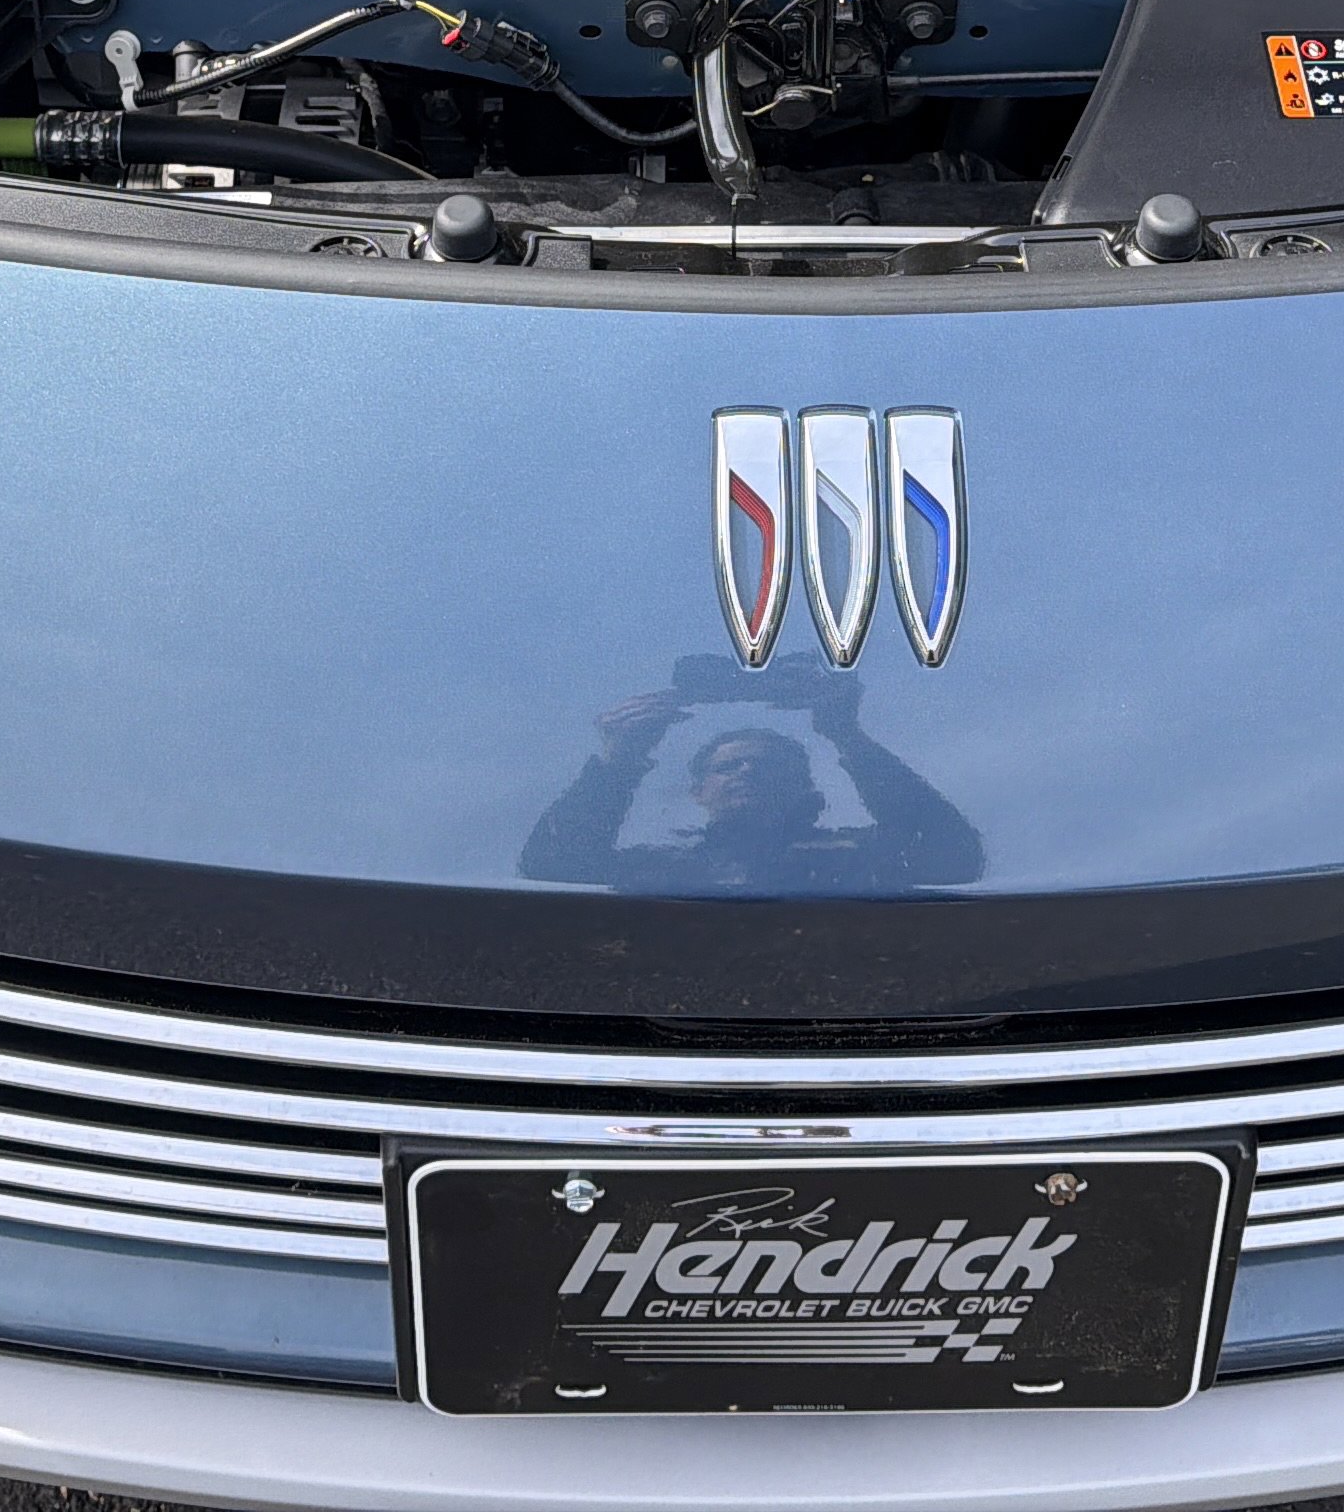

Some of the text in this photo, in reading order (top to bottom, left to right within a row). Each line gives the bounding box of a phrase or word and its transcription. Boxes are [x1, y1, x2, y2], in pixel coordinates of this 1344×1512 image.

[670, 1186, 836, 1239] Rick
[558, 1216, 1078, 1318] Hendrick
[643, 1295, 1034, 1318] CHEVROLET BUICK GMC
